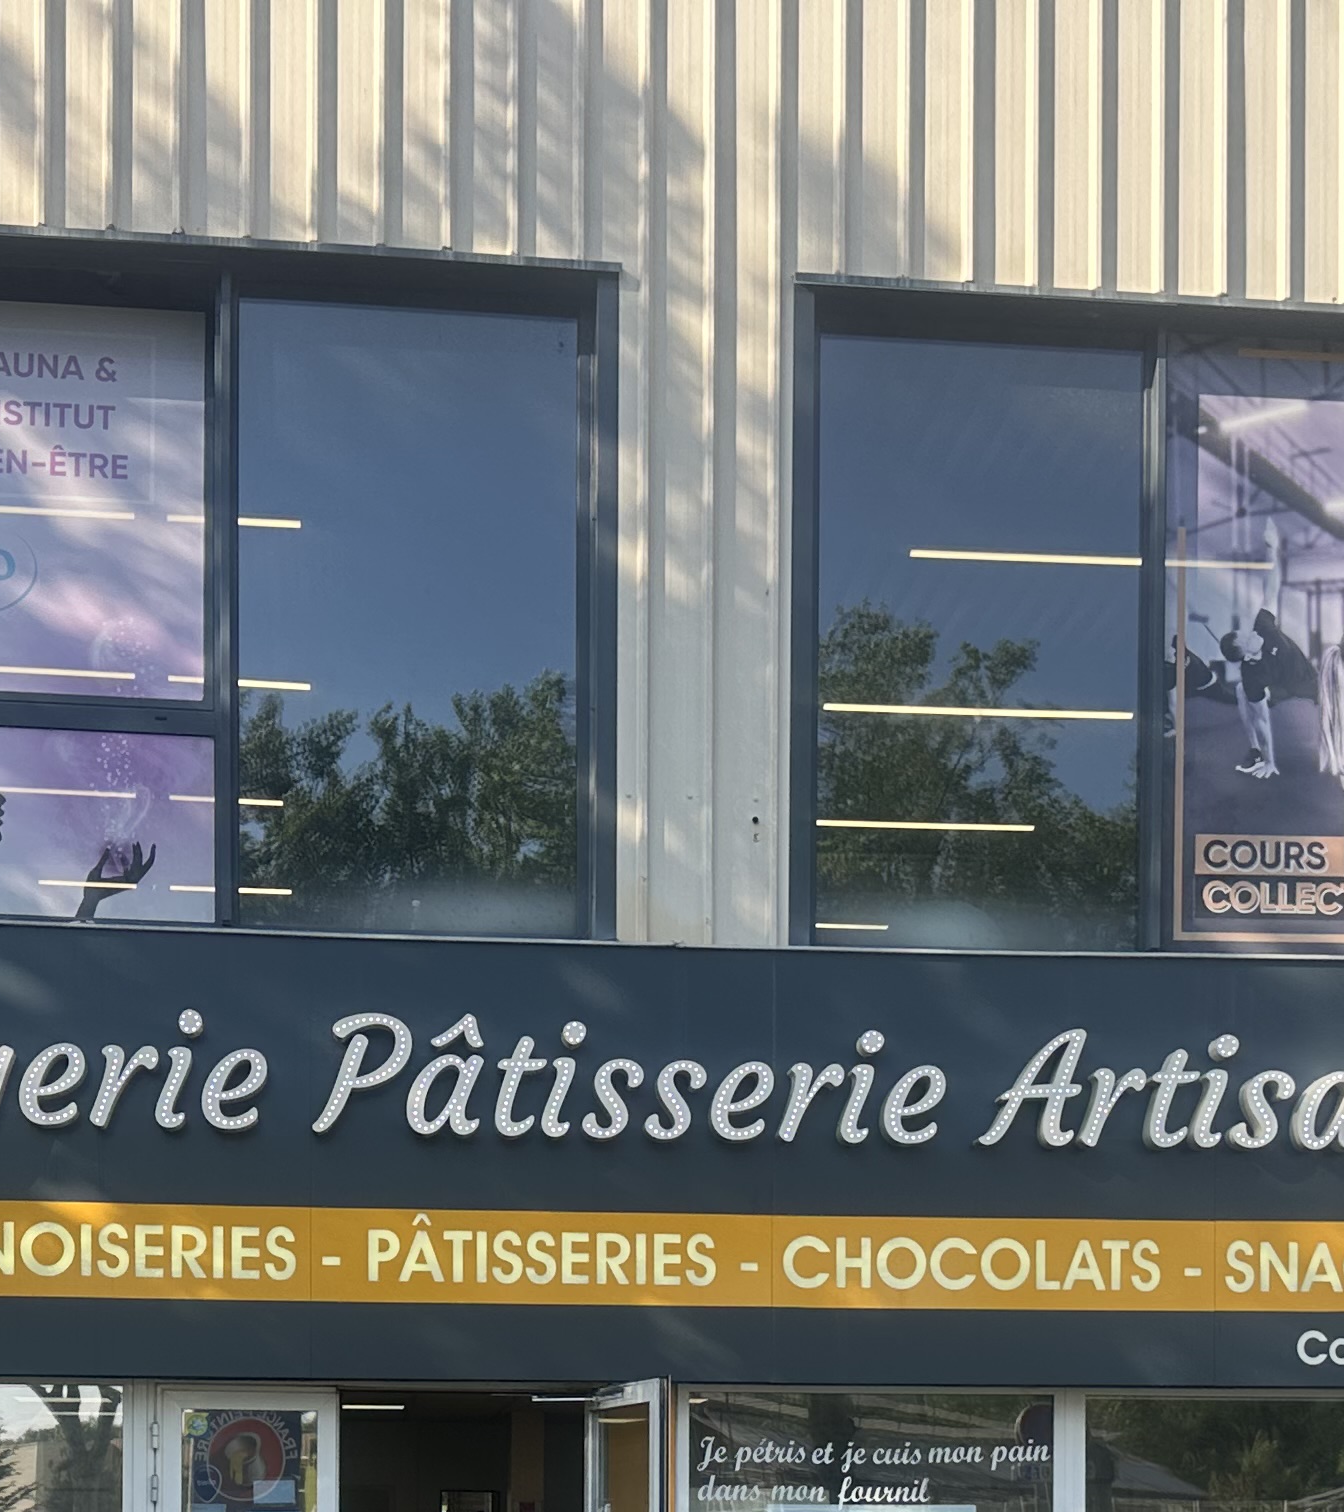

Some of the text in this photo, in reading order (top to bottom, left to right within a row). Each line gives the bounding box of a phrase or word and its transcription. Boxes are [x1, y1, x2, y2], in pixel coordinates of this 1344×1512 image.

[95, 356, 118, 382] &
[1203, 839, 1329, 873] COURS
[311, 1012, 948, 1145] Pâtisserie
[367, 1214, 718, 1286] PÂTISSERIES
[782, 1235, 1160, 1291] CHOCOLATS
[697, 1436, 1051, 1473] Je pétris et je cuis mon pain
[697, 1475, 931, 1510] dans mon fournil
